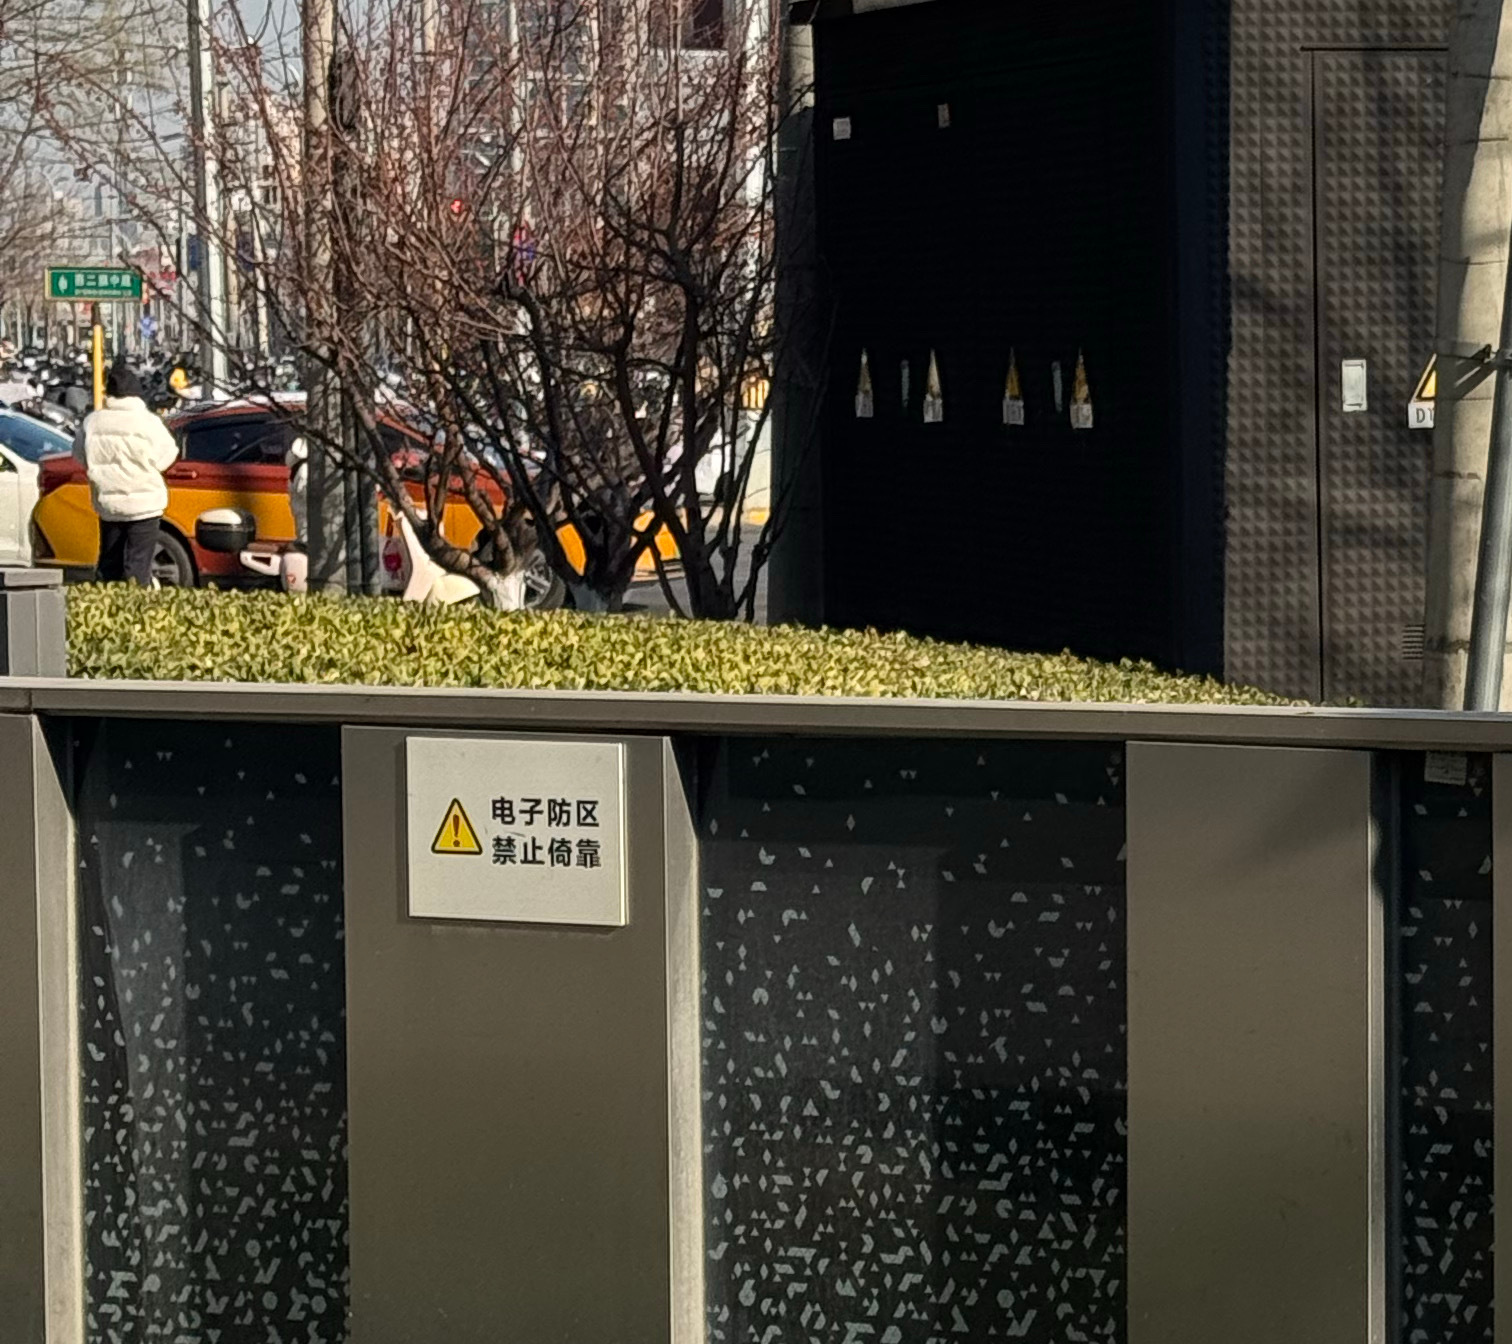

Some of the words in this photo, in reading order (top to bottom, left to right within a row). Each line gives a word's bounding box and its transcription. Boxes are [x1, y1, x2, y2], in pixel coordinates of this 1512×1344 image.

[491, 796, 600, 827] 电子防区
[491, 836, 602, 869] 禁止倚靠
